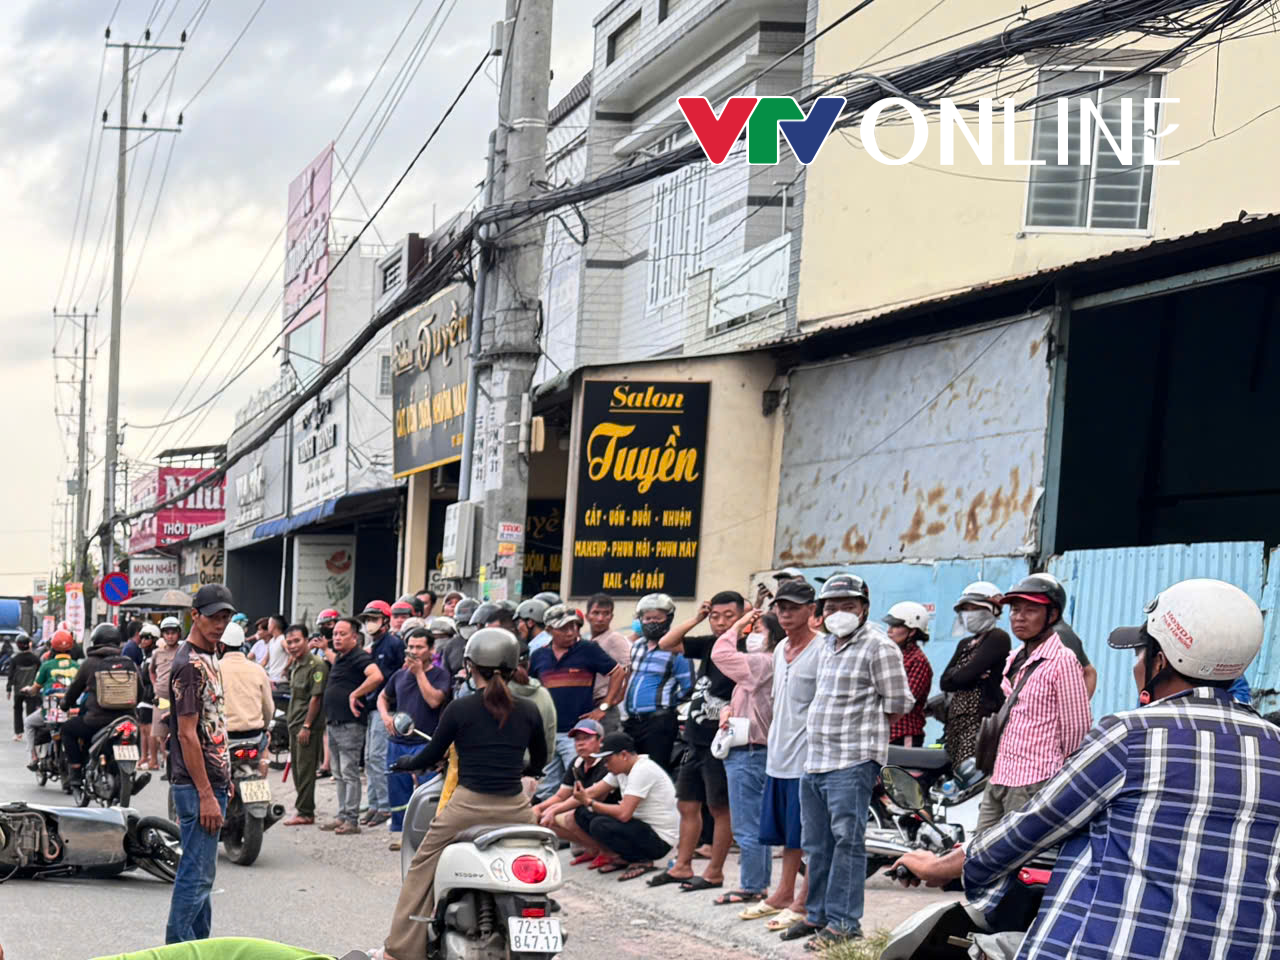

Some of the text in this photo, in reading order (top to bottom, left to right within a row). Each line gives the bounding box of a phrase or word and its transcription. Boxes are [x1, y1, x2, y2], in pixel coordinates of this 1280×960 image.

[610, 385, 684, 408] Salon
[587, 422, 699, 494] Tuyền
[574, 540, 607, 557] MAKEUP
[611, 540, 633, 557] PHUN
[655, 540, 677, 557] PHUN
[134, 564, 153, 574] MINH
[602, 572, 622, 589] NAIL
[514, 936, 559, 950] 847.17
